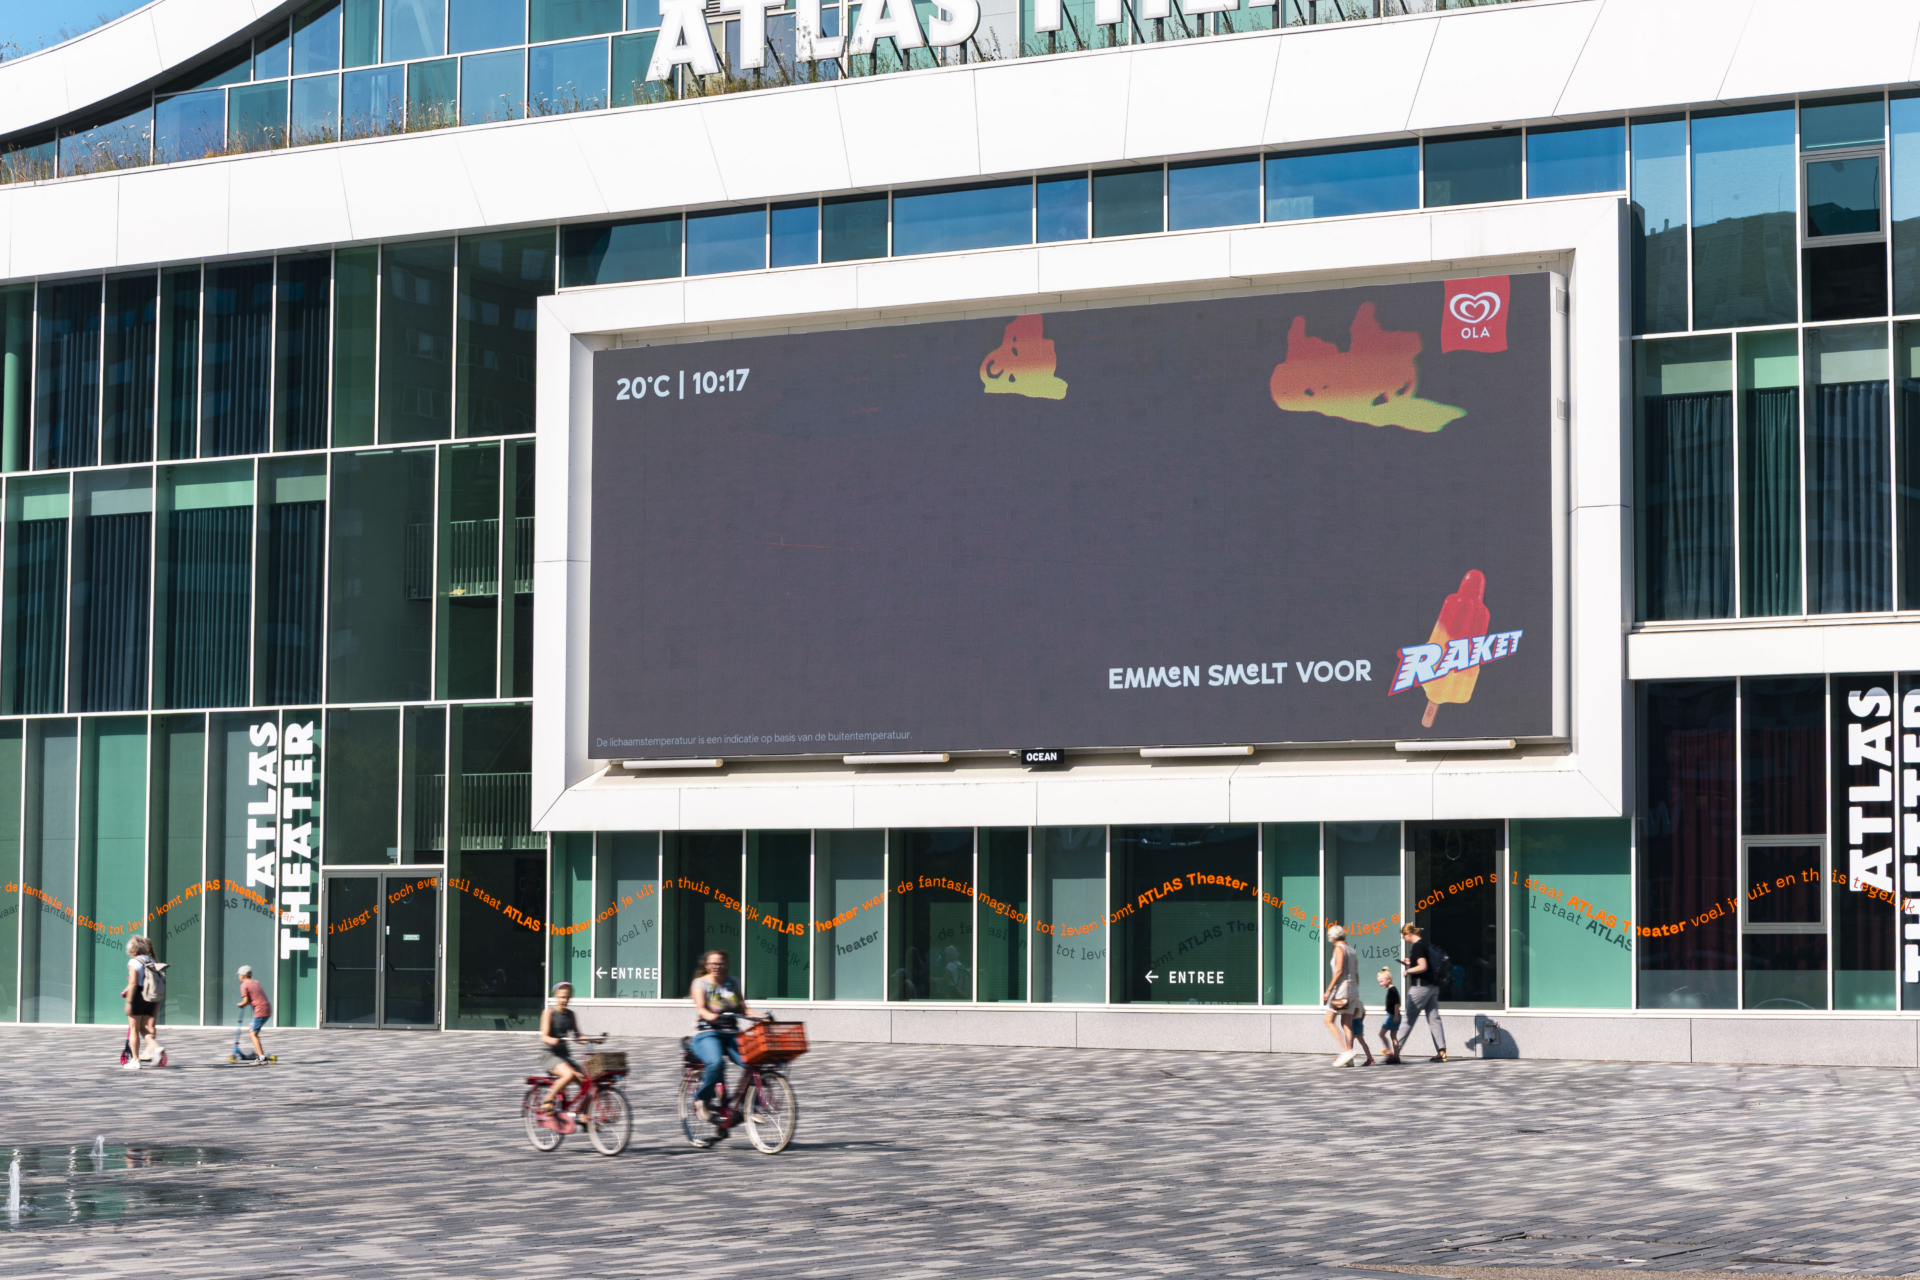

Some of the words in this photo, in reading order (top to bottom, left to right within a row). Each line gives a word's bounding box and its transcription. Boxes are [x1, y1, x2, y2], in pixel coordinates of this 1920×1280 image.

[1461, 326, 1490, 339] OLA
[616, 374, 671, 400] 20°C
[693, 368, 750, 395] 10:17
[1296, 659, 1372, 683] VOOR
[1391, 629, 1524, 694] RAKET
[597, 737, 608, 748] De
[609, 736, 697, 748] lichaamstemperatuur
[698, 735, 705, 745] is
[706, 736, 722, 744] een
[724, 734, 759, 744] indicatie
[761, 734, 773, 745] op
[774, 733, 796, 743] basis
[798, 733, 813, 742] van
[814, 732, 826, 742] de
[828, 731, 913, 743] buitentemperatuur.
[1026, 752, 1057, 761] OCEAN
[1848, 686, 1892, 892] ATLAS
[247, 722, 278, 888] ATLAS
[281, 721, 314, 960] THEATER
[5, 881, 18, 892] de
[23, 882, 62, 910] fantasie
[64, 907, 106, 933] mgisch
[109, 924, 124, 935] tot
[127, 918, 155, 934] levn
[156, 894, 183, 917] komt
[224, 879, 268, 906] Theater
[337, 909, 371, 933] vliegt
[388, 883, 414, 904] toch
[417, 877, 438, 890] eve
[449, 877, 470, 893] stil
[473, 887, 502, 911] staat
[503, 904, 541, 932] ATLAS
[544, 919, 592, 936] heater
[595, 901, 620, 924] voel
[621, 896, 633, 911] je
[636, 883, 655, 900] uit
[678, 876, 713, 895] thuis
[761, 914, 805, 936] ATLAS
[897, 880, 914, 894] de
[918, 875, 974, 897] fantasie
[1036, 919, 1056, 936] tot
[1060, 922, 1099, 937] leven
[1137, 877, 1183, 909] ATLAS
[1186, 871, 1249, 891] Theater
[1289, 905, 1307, 921] de
[1448, 875, 1484, 895] even
[1524, 878, 1564, 902] staat
[1566, 895, 1618, 929] ATLAS
[1690, 902, 1726, 927] voel
[1727, 897, 1739, 914] je
[1747, 881, 1772, 900] uit
[1775, 873, 1796, 889] en
[1801, 867, 1847, 885] this
[611, 967, 658, 980] ENTREE
[1169, 971, 1225, 984] ENTREE
